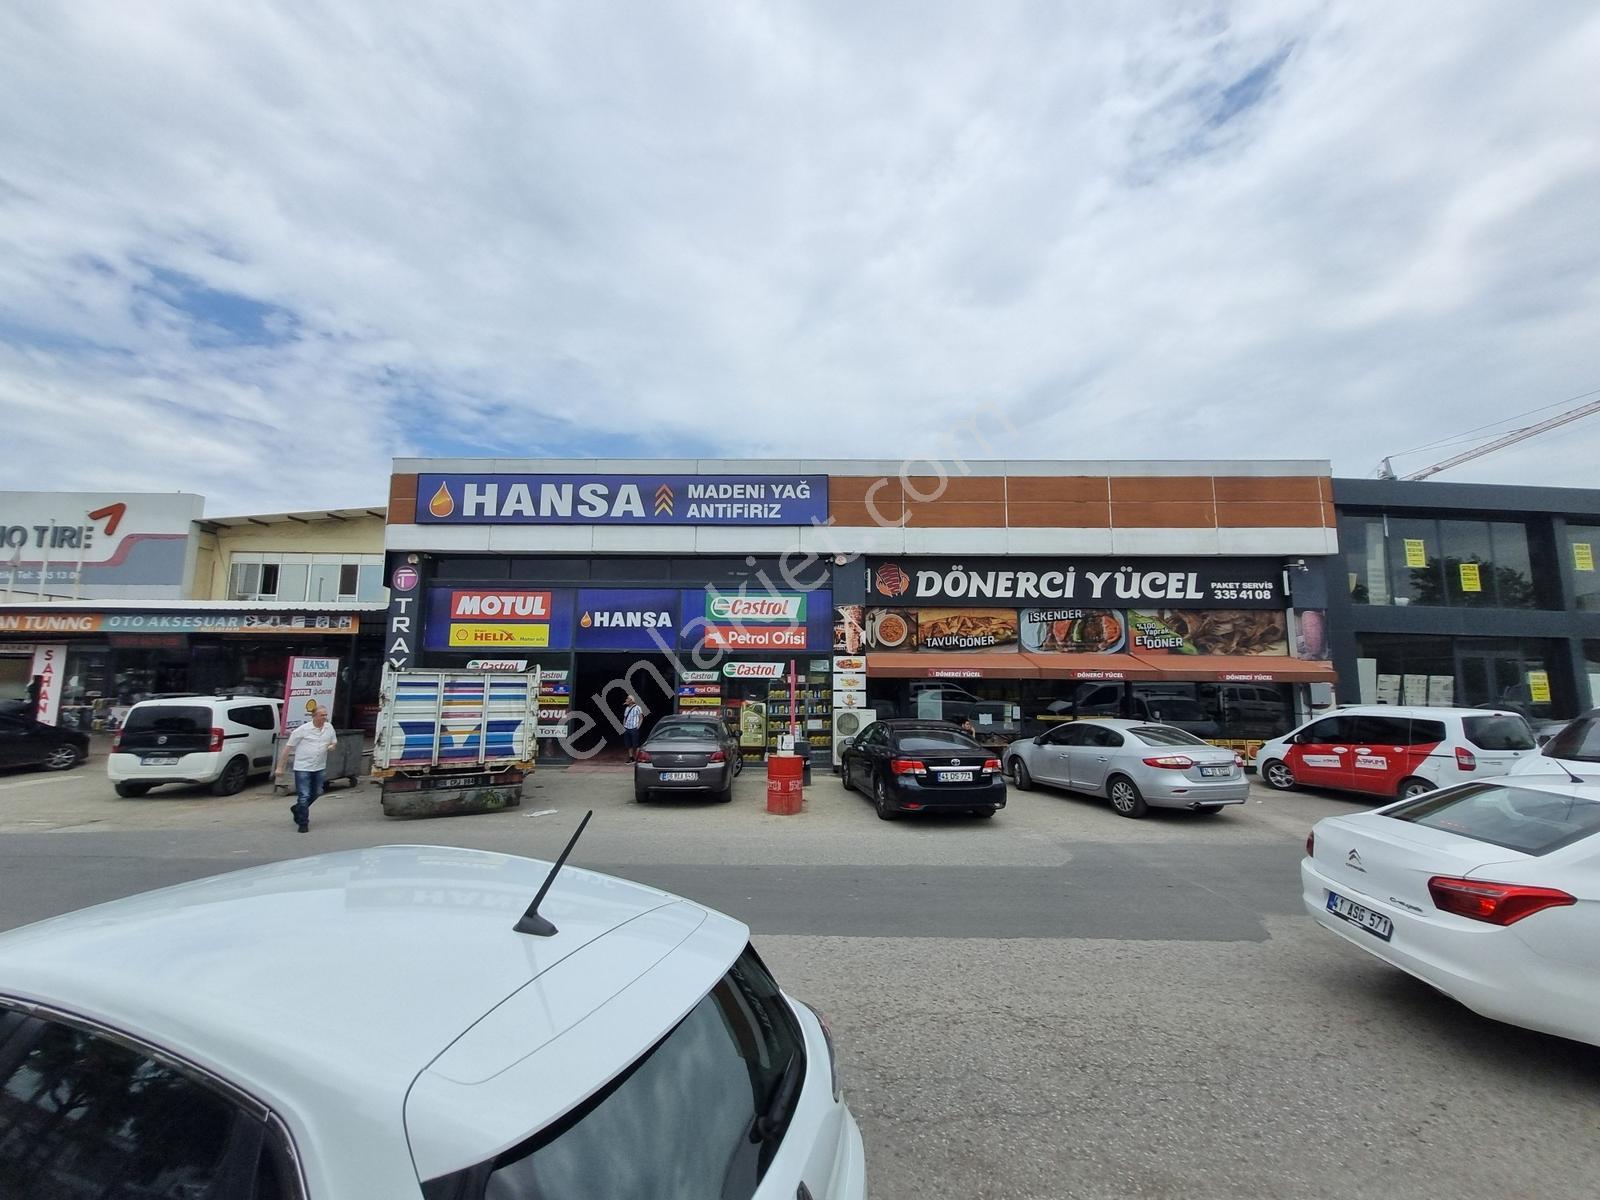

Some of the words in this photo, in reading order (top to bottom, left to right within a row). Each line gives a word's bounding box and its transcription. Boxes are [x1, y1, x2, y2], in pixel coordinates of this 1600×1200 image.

[770, 480, 811, 499] YAĞ
[462, 483, 646, 517] HANSA
[33, 525, 94, 549] TIRE
[915, 564, 1076, 599] DÖNERCİ
[1085, 565, 1205, 599] YÜCEL
[1210, 582, 1241, 590] PAKET
[1241, 580, 1274, 590] SERVİS
[1214, 589, 1238, 600] 335
[1239, 589, 1253, 600] 41
[1254, 589, 1271, 600] 08
[456, 595, 546, 616] MOTUL
[731, 599, 789, 616] Castrol
[109, 616, 144, 627] OTO
[146, 616, 239, 628] AKSESUAR
[593, 611, 673, 628] HANSA
[1029, 609, 1082, 622] İSKENDER
[474, 632, 514, 641] HELIX
[728, 631, 769, 645] Petrol
[772, 631, 806, 645] Ofisi
[926, 635, 959, 648] TAVUK
[959, 634, 995, 648] DÖNER
[1135, 635, 1149, 646] ET
[1147, 636, 1183, 649] DÖNER
[480, 661, 520, 673] Castrol
[736, 663, 776, 676] Castrol
[37, 649, 54, 714] SAHAN
[690, 672, 715, 680] Castrol
[538, 709, 568, 719] OTUL
[1333, 896, 1344, 912] 41
[1346, 903, 1366, 923] ASG
[1368, 912, 1389, 934] 571
